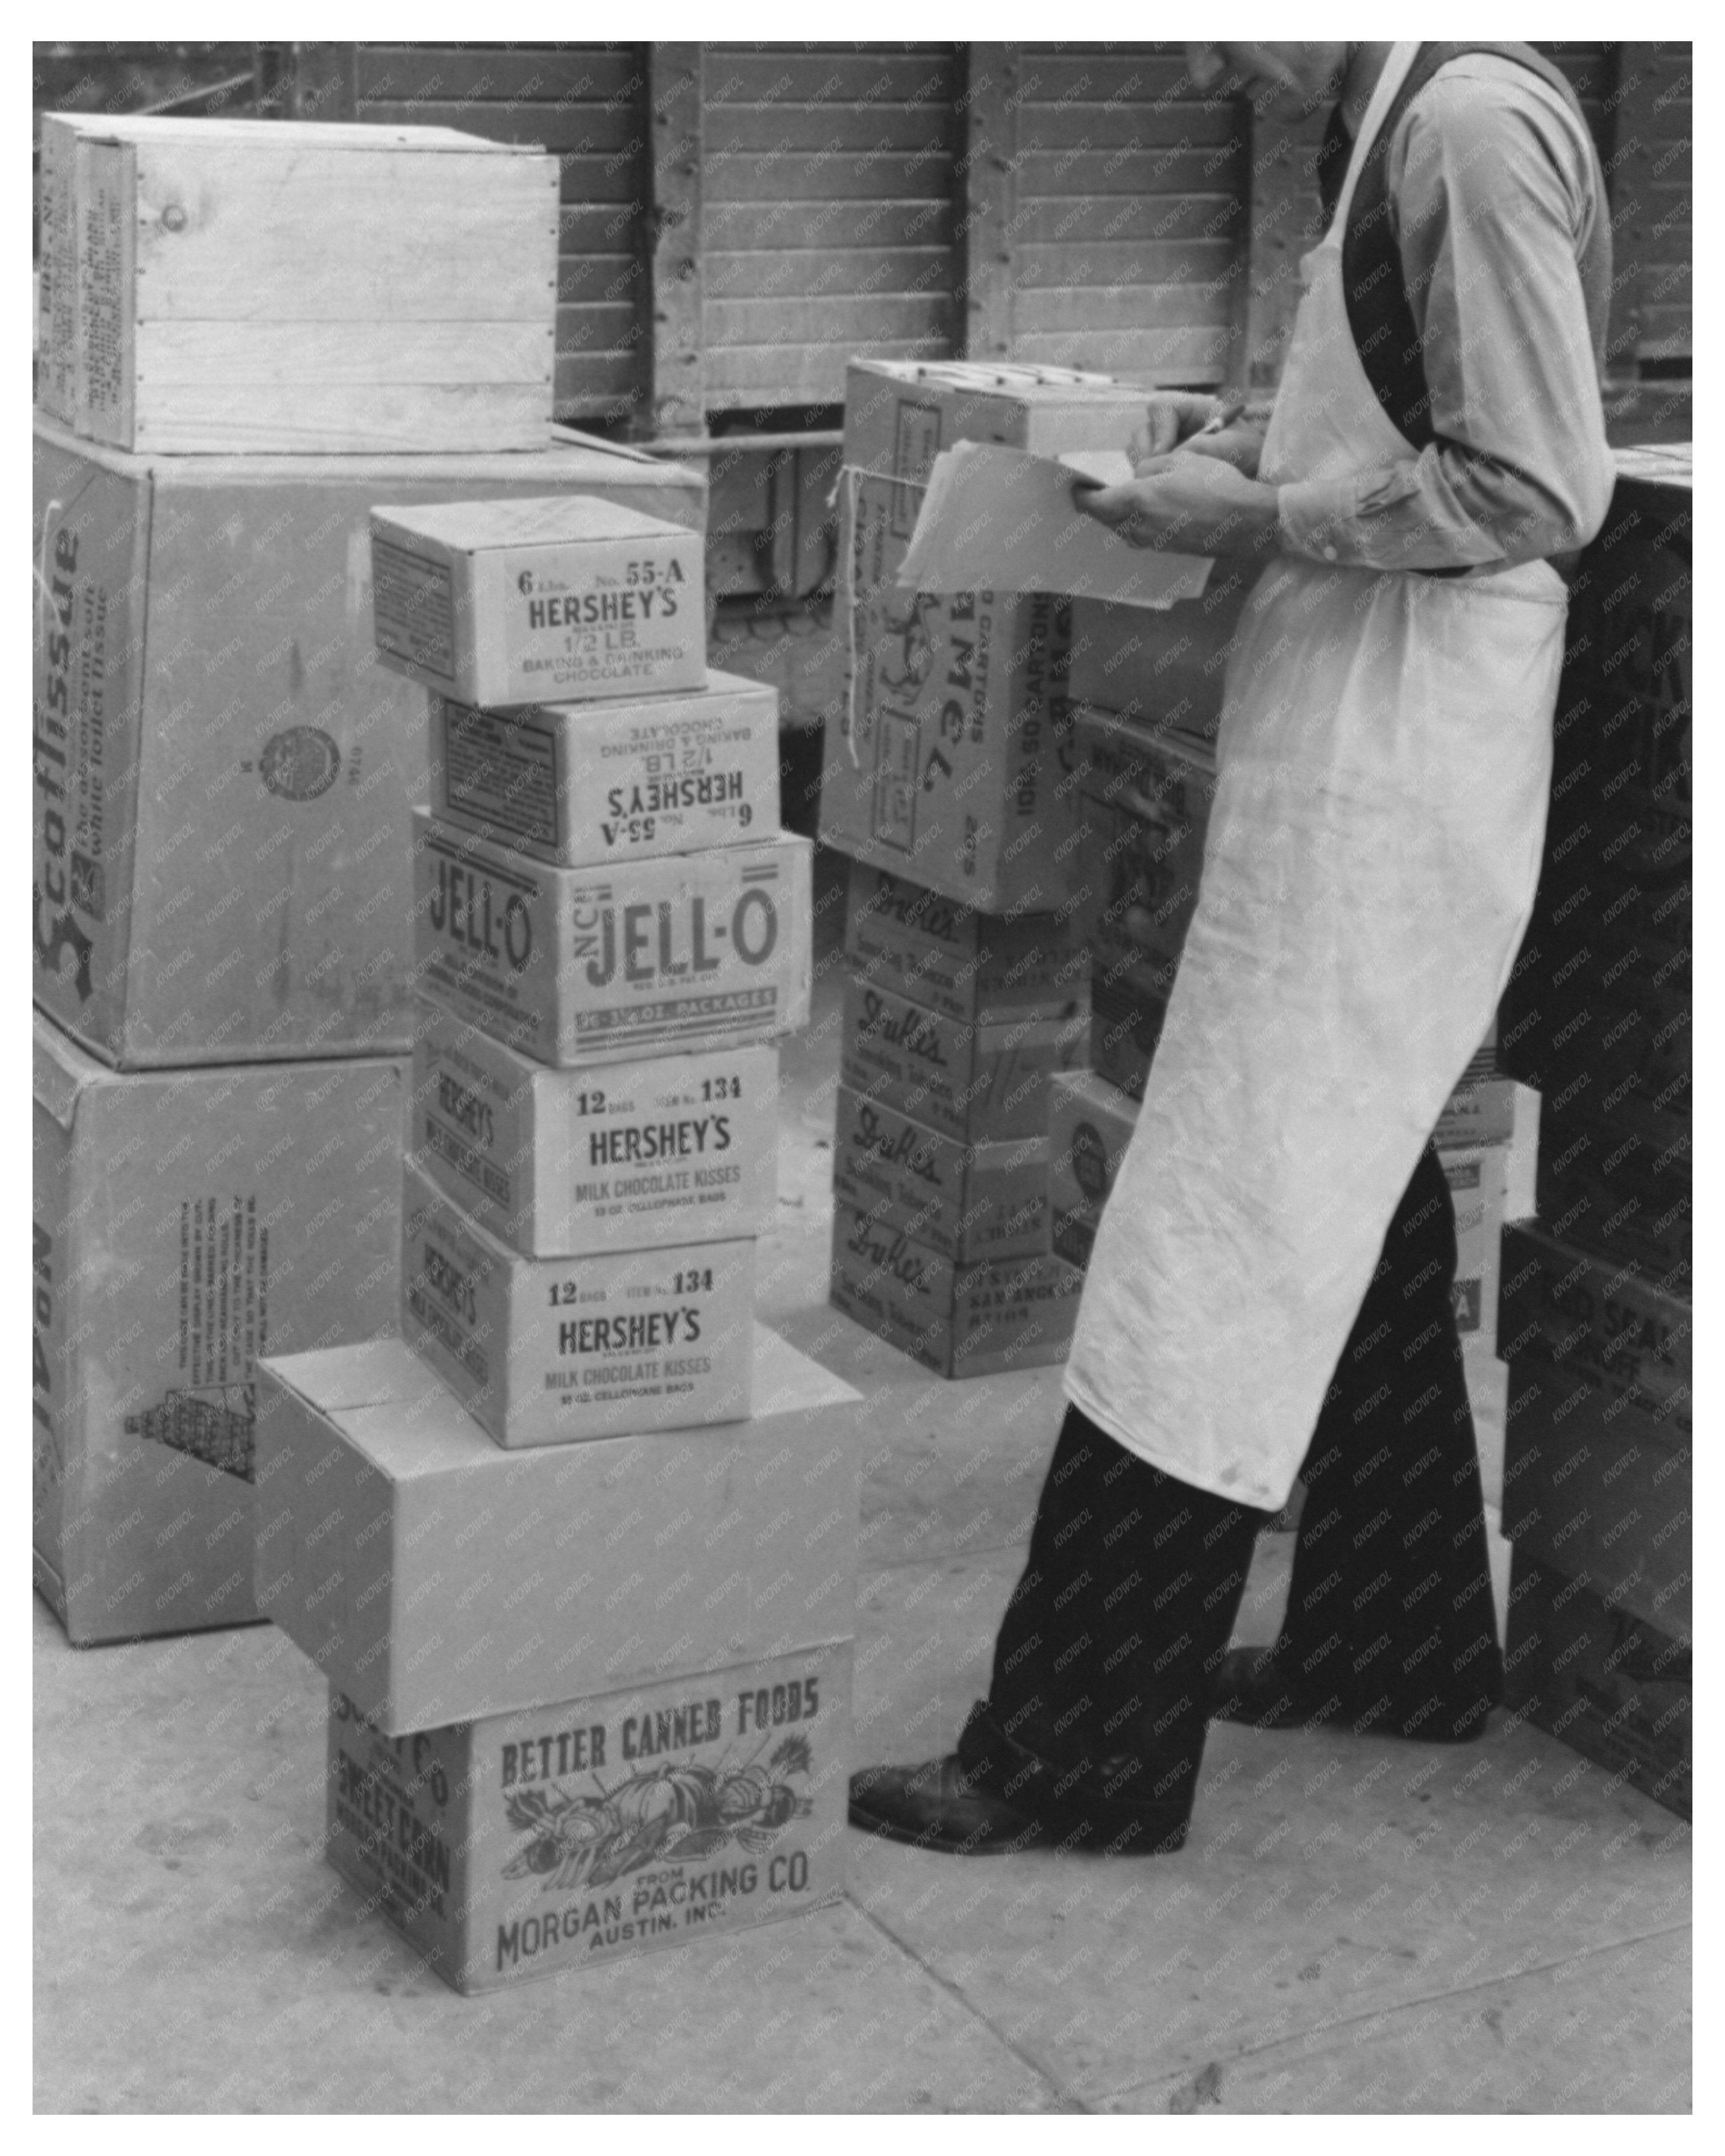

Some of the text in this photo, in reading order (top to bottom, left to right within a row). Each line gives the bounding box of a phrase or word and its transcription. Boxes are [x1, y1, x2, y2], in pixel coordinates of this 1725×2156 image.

[518, 570, 534, 595] 6
[626, 558, 685, 586] 55-A
[529, 585, 678, 630] HERSHEY'S
[522, 657, 584, 673] BAKING
[605, 646, 683, 666] DRINKING
[564, 630, 642, 655] 1/2 LB.
[553, 663, 653, 685] CHOCOLATE
[923, 591, 975, 792] AMEL
[971, 615, 992, 744] CARTONS
[631, 717, 723, 740] CHOCOLATE
[696, 727, 751, 746] BAKING
[600, 738, 675, 758] DRINKING
[607, 770, 743, 820] HERSHEY'S
[600, 817, 656, 846] 55-A
[738, 803, 753, 827] 6
[430, 859, 532, 974] JELL-O
[586, 888, 778, 988] JELL-O
[677, 989, 775, 1016] PACKAGES
[577, 1091, 606, 1117] 12
[701, 1075, 741, 1102] 134
[590, 1114, 731, 1166] HERSHEY'S
[575, 1165, 741, 1202] MILK CHOCOLATE KISSES
[628, 1196, 695, 1213] CELLOPHANE
[699, 1192, 727, 1204] BAGS
[548, 1280, 577, 1307] 12
[673, 1268, 714, 1295] 134
[559, 1306, 701, 1356] HERSHEY'S
[545, 1355, 711, 1391] MILK CHOCOLATE KISSES
[594, 1384, 663, 1402] CELLOPHANE
[665, 1381, 694, 1395] BAGS
[501, 1677, 819, 1788] BETTER CANNED FOODS
[635, 1866, 684, 1889] FROM
[497, 1850, 812, 1971] MORGAN PACKING CO.
